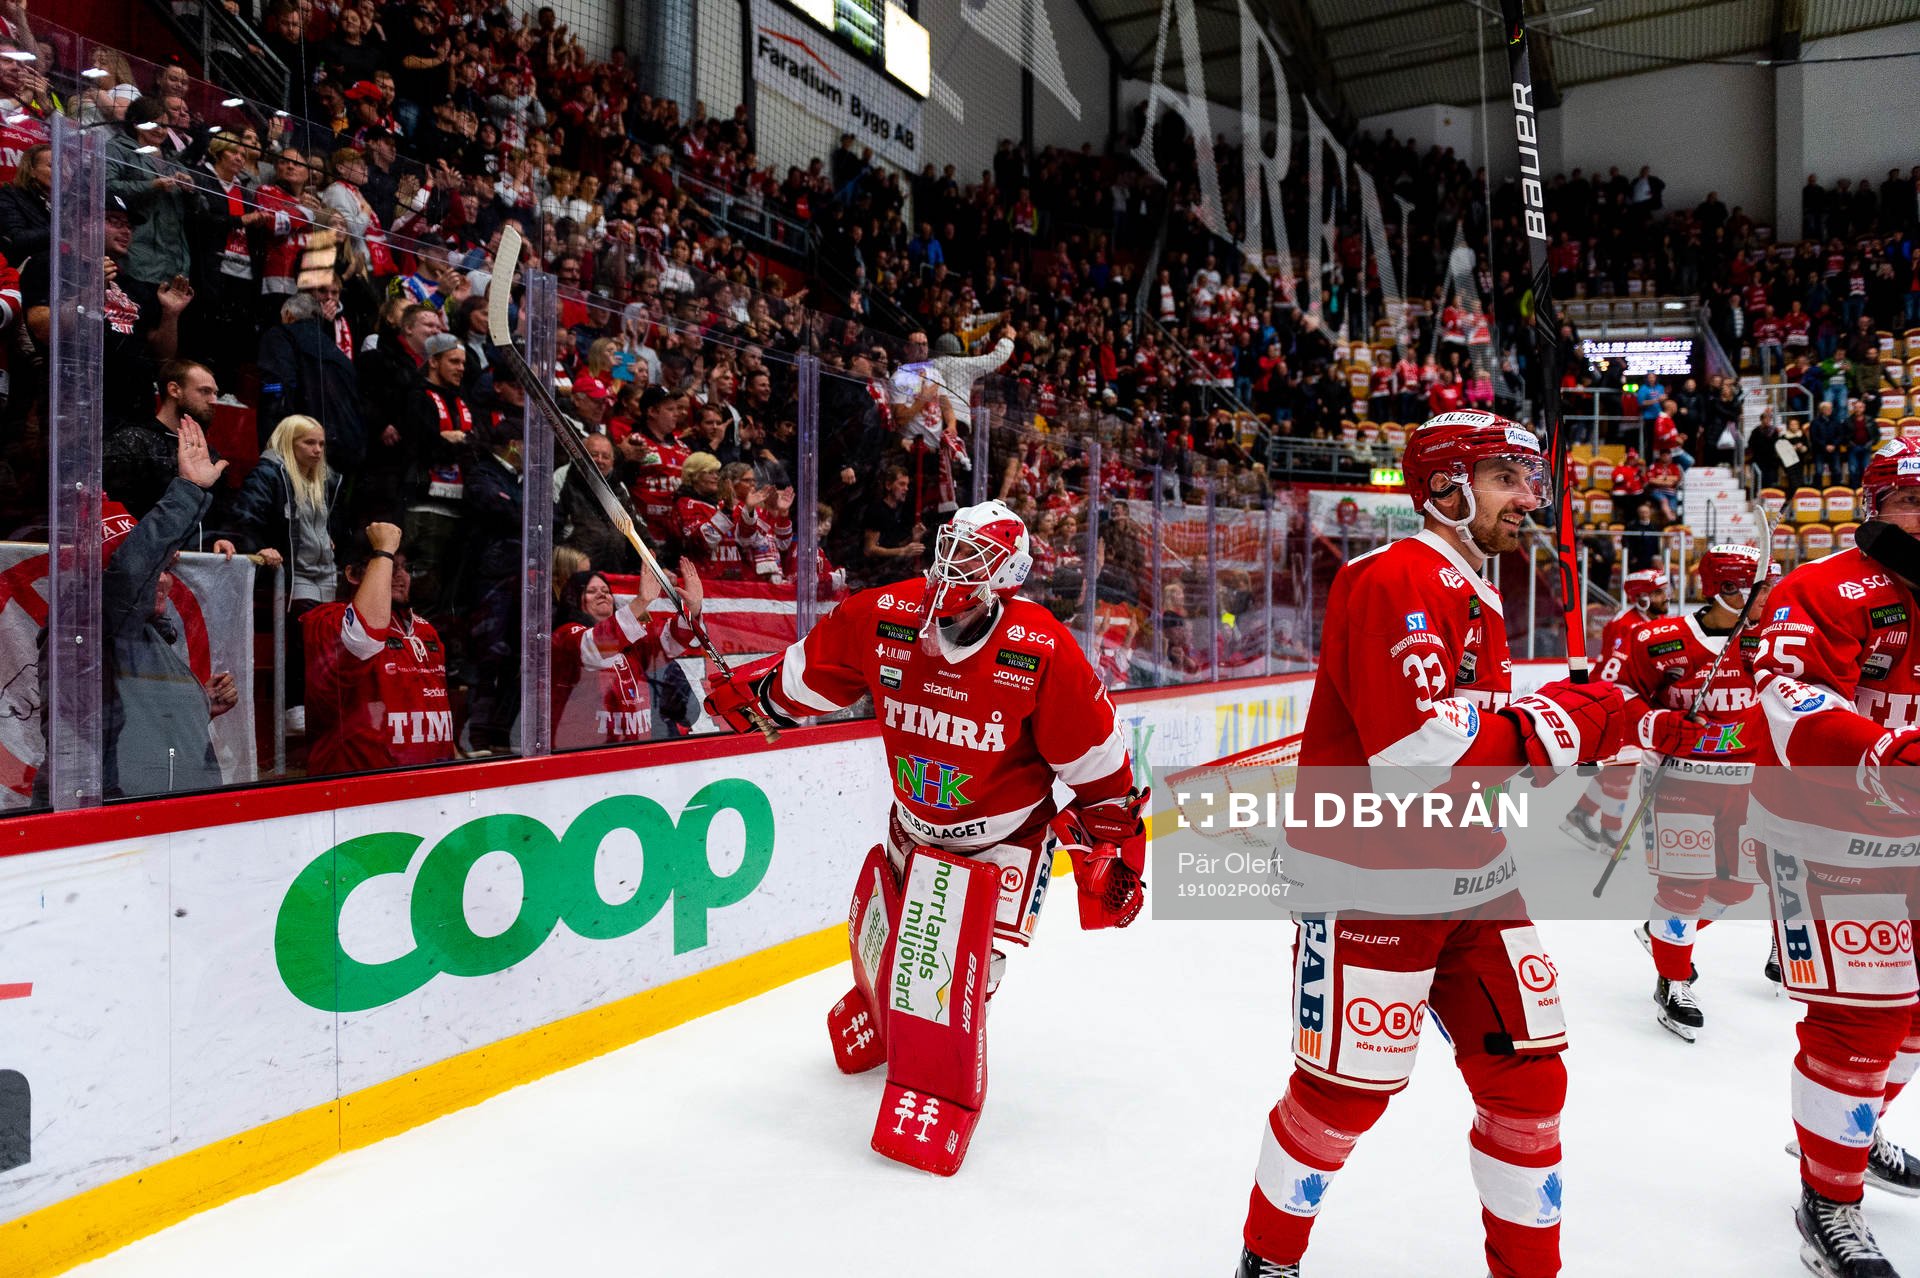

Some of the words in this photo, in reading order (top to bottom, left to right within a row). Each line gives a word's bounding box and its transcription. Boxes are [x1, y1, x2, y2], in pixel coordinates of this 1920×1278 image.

[758, 34, 842, 106] Faradium
[850, 95, 889, 139] Bygg
[894, 122, 914, 150] AB
[1512, 82, 1547, 241] BAUER
[1862, 573, 1894, 590] SCA
[896, 600, 925, 614] SCA
[1774, 607, 1790, 621] ST
[1407, 613, 1425, 631] ST
[1652, 625, 1680, 636] SCA
[1026, 632, 1055, 650] SCA
[886, 647, 912, 662] LILIUM
[999, 650, 1037, 665] GRÖNSAKS
[1007, 658, 1030, 669] HUSET
[937, 669, 962, 679] BAUER
[993, 670, 1035, 686] JOWIC
[1402, 652, 1446, 713] 33
[922, 682, 969, 702] stadium
[884, 696, 1006, 752] TIMRÅ
[894, 754, 975, 811] NHK
[902, 806, 987, 840] BILBOLAGET
[1453, 855, 1518, 896] BILBOLA
[274, 777, 775, 1013] coop
[919, 861, 952, 981] norrlands
[1339, 930, 1400, 945] BAUER
[1847, 960, 1867, 968] RÖR
[962, 951, 977, 1034] BAUER
[1356, 1041, 1375, 1052] RÖR
